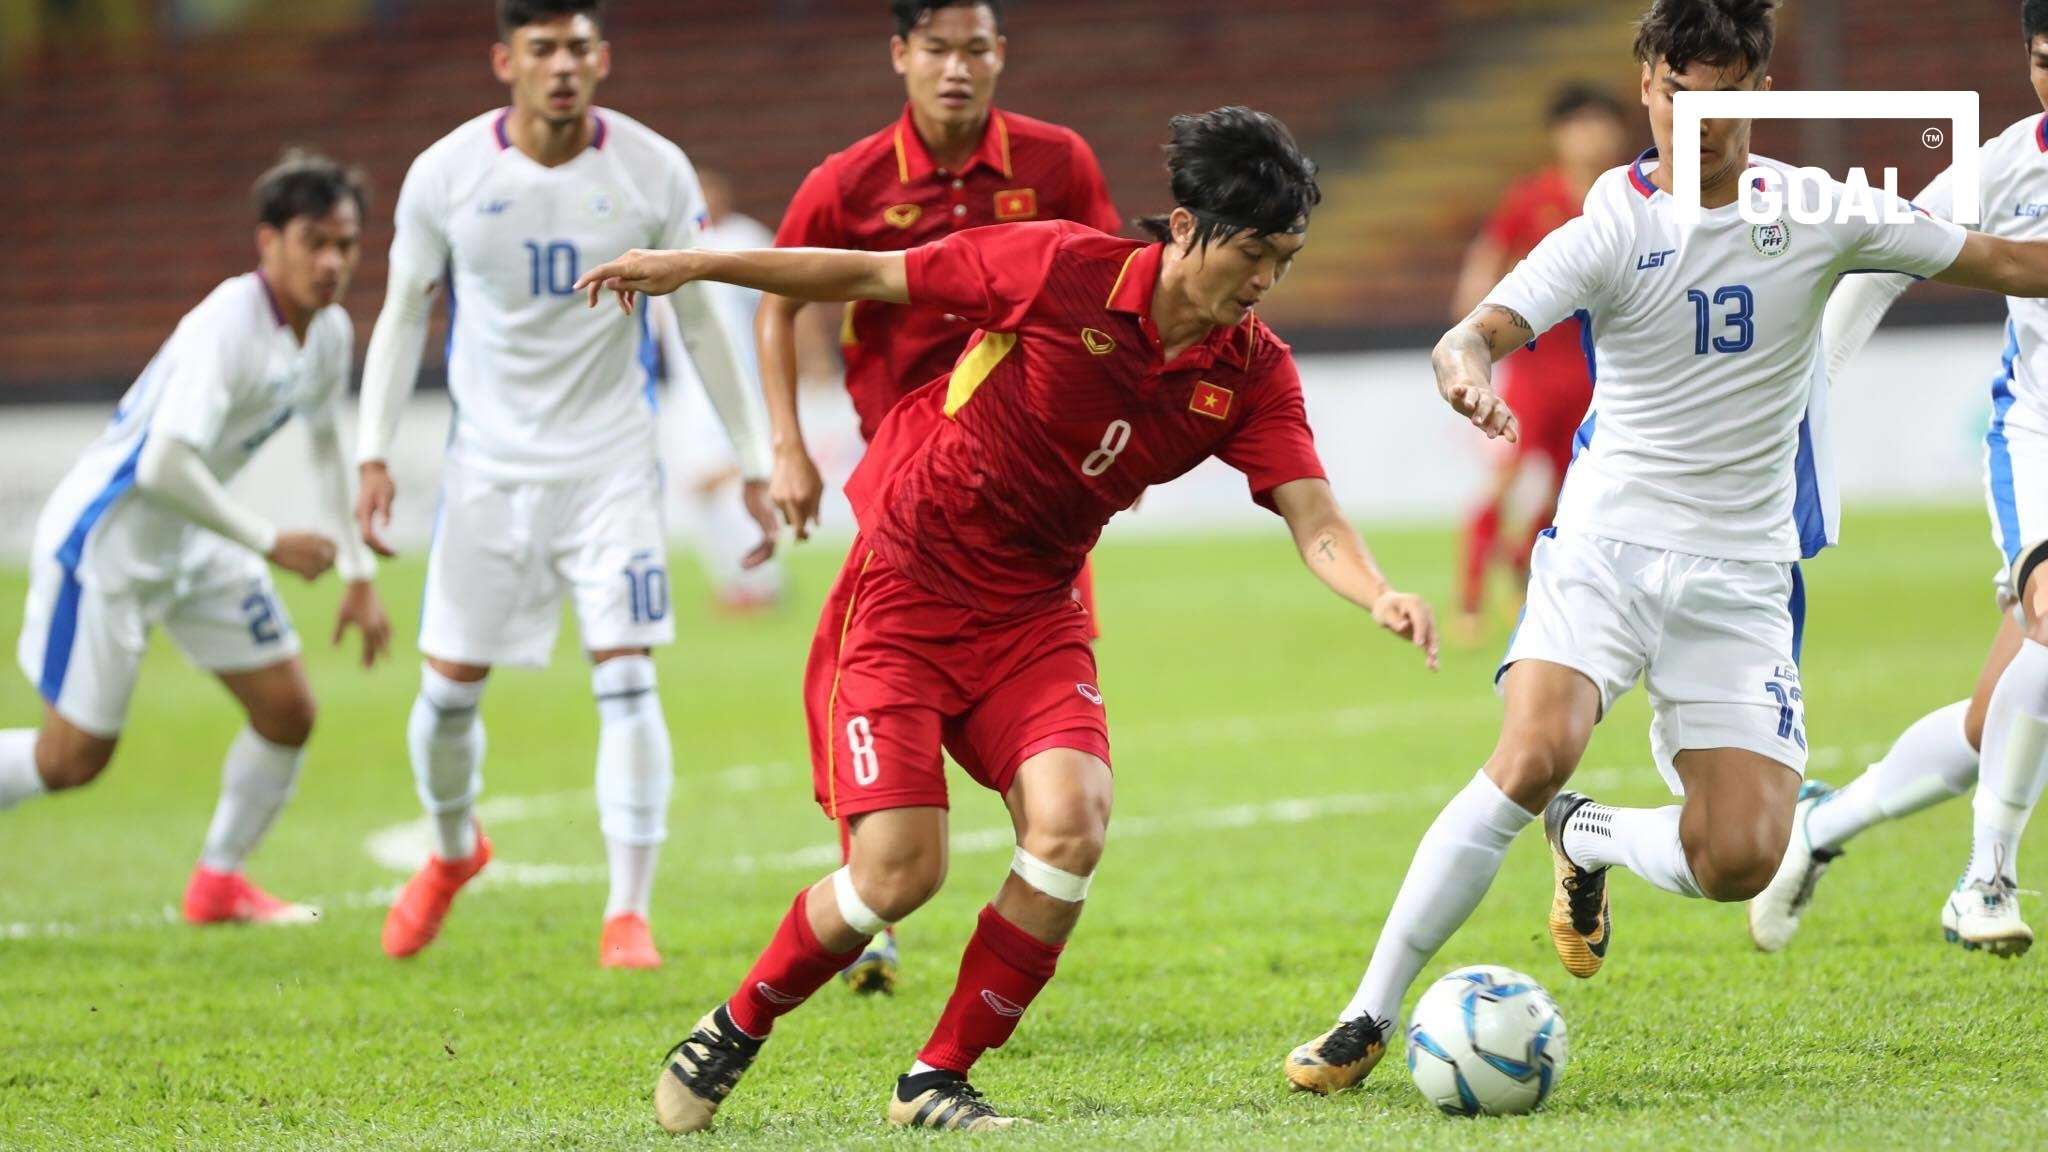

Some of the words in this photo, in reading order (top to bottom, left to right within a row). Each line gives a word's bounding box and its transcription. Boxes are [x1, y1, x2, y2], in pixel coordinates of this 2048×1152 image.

[522, 238, 579, 296] 10
[1762, 237, 1782, 247] PFF
[1687, 284, 1754, 355] 13
[1081, 419, 1131, 476] 8
[622, 567, 668, 623] 10
[846, 715, 880, 786] 8
